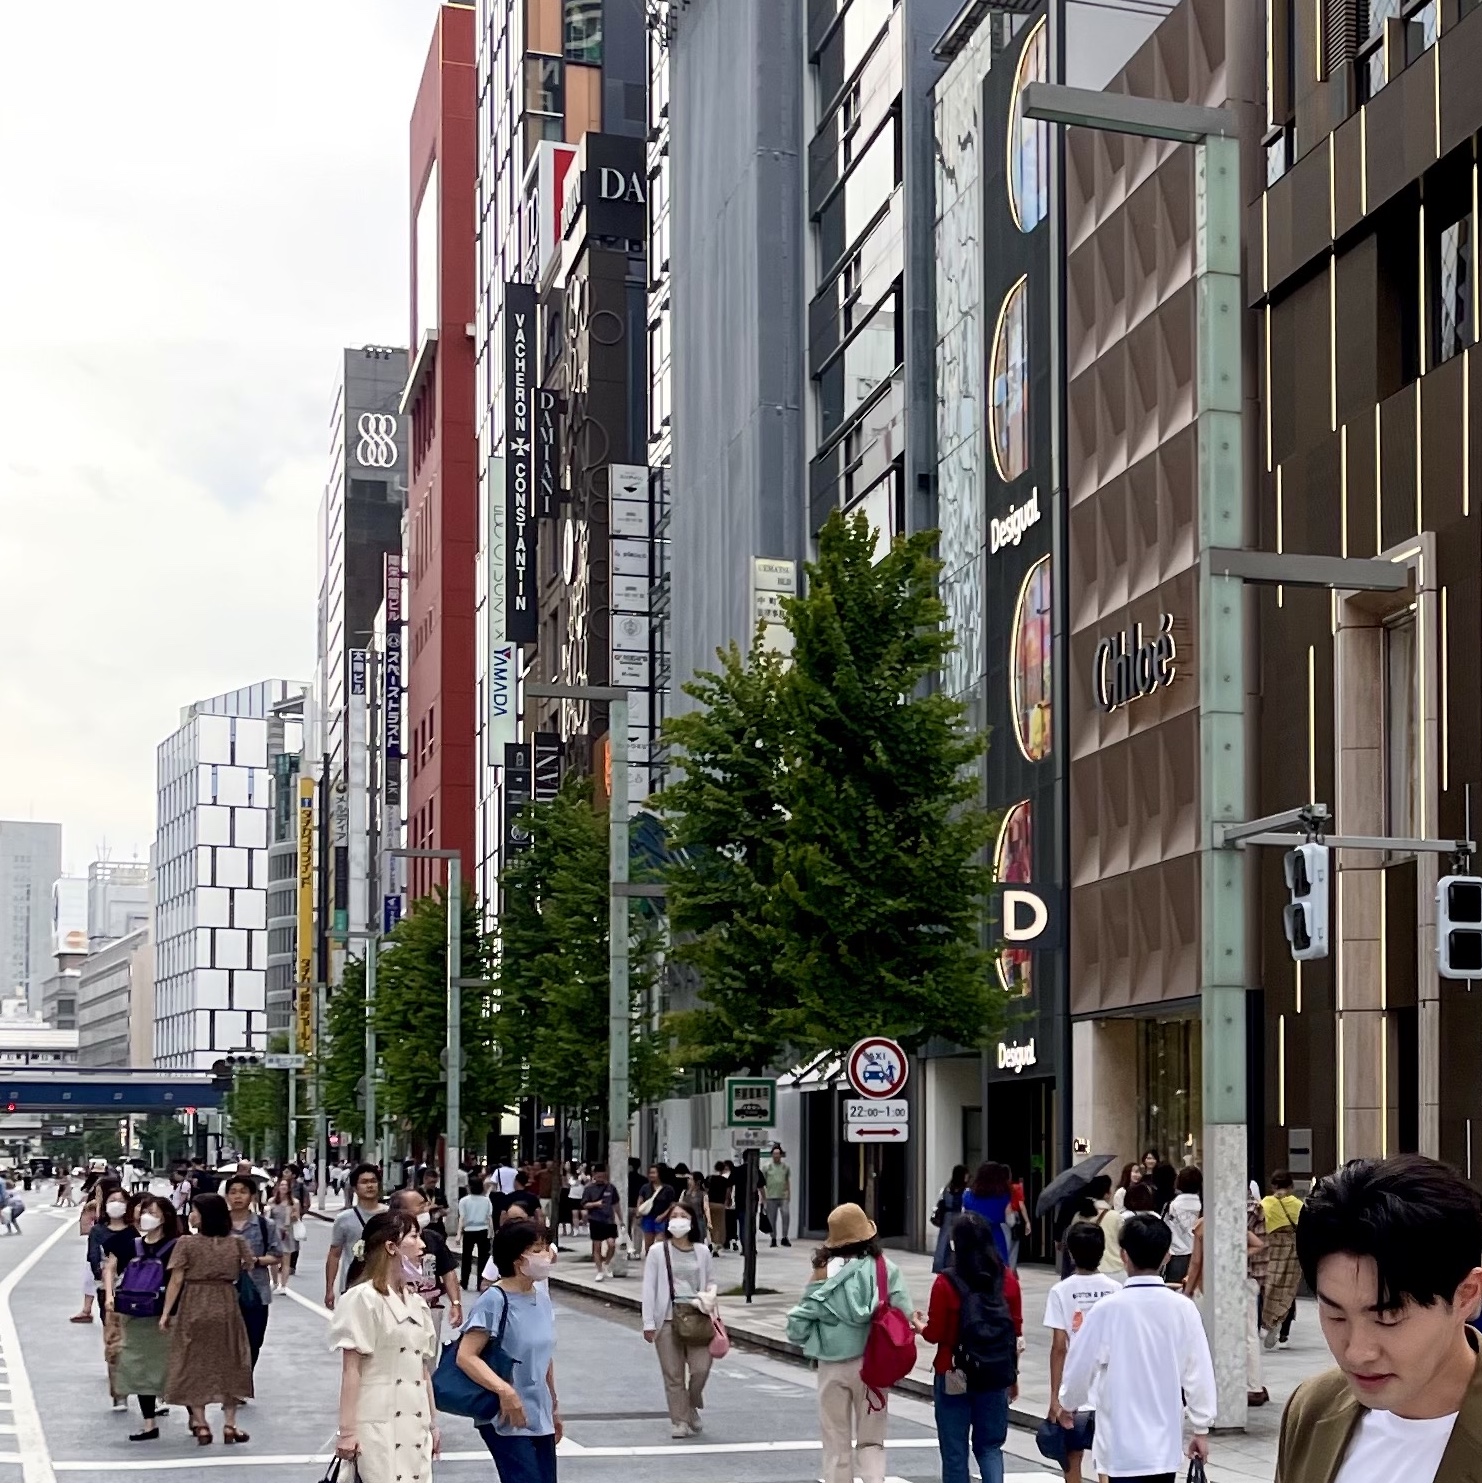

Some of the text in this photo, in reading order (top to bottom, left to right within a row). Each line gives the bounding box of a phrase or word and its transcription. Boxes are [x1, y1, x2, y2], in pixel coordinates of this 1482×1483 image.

[514, 313, 527, 612] VACHERON CONSTANTIN
[540, 391, 555, 514] DAMIANI
[387, 651, 399, 748] スペーストラスト
[493, 646, 512, 717] YAMADA
[1091, 613, 1176, 713] Chloé
[1003, 890, 1048, 941] D
